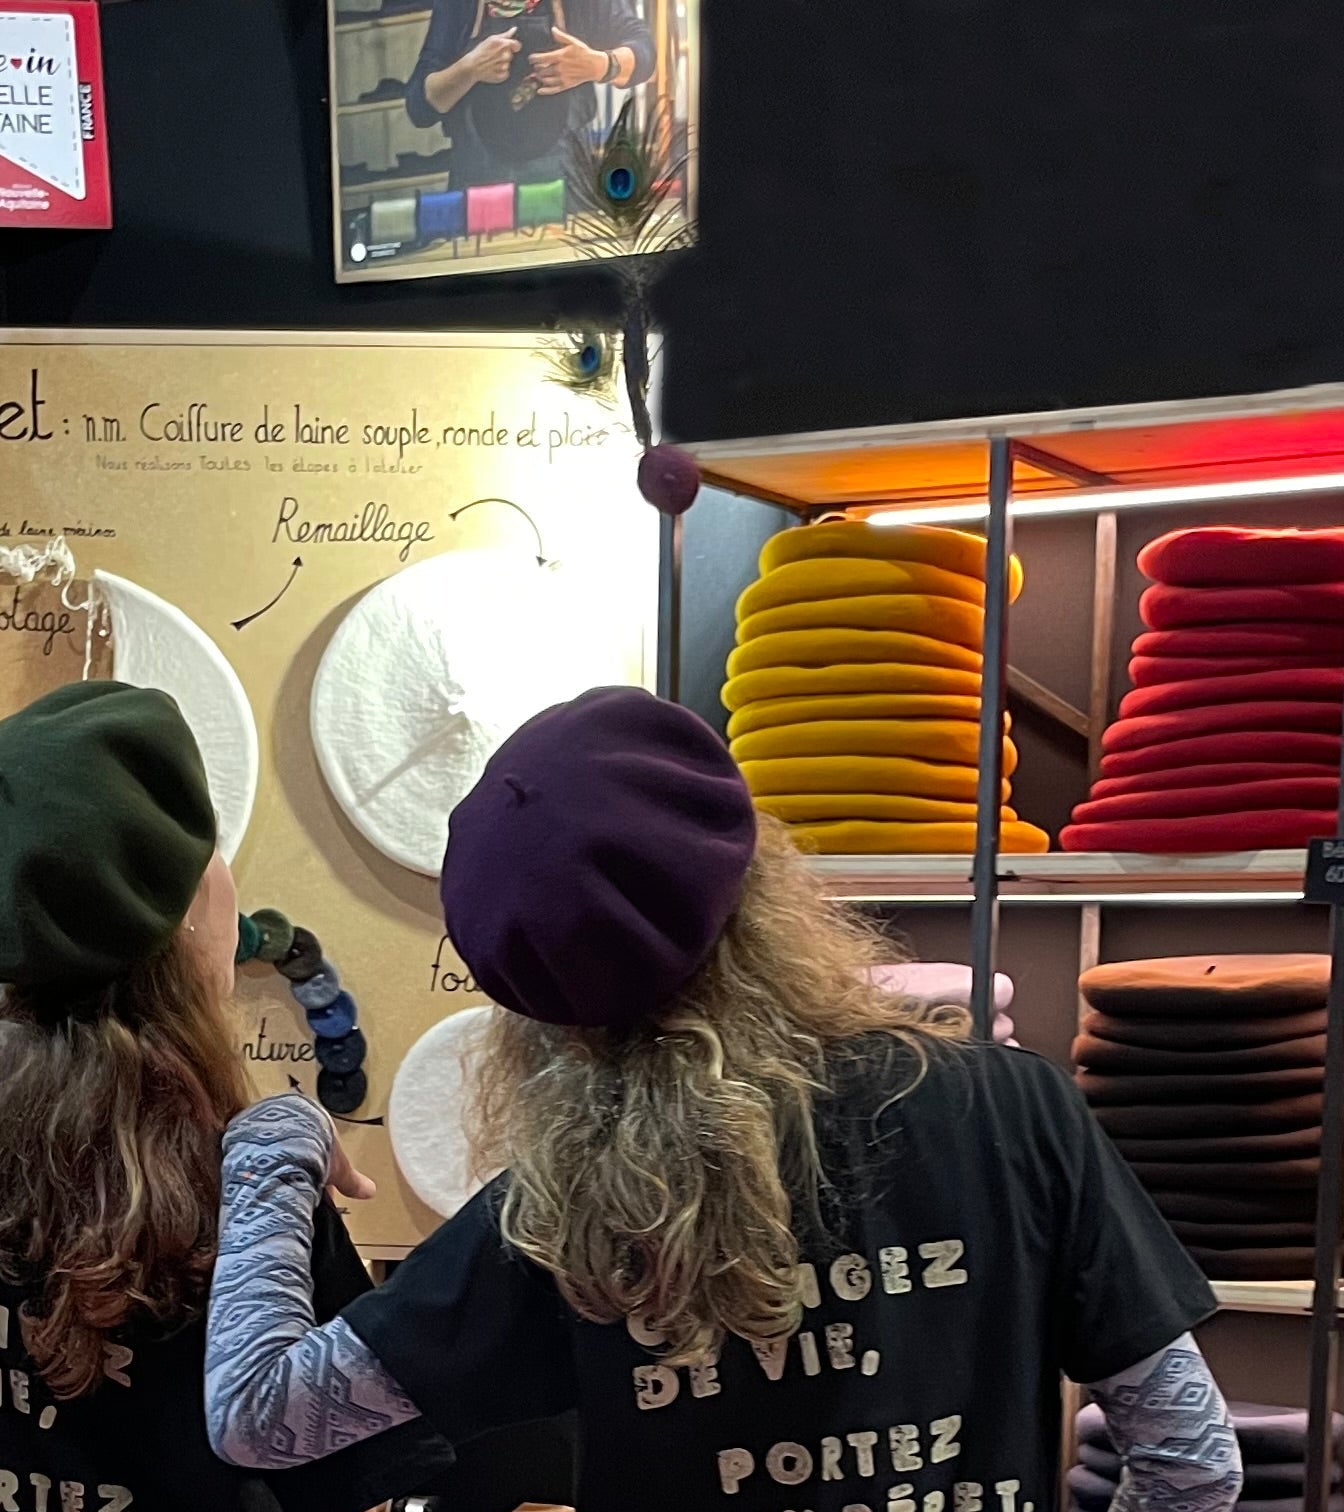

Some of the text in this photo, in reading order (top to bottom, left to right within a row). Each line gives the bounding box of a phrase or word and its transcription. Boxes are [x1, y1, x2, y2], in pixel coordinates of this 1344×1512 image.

[25, 47, 61, 75] in
[140, 402, 244, 443] Coiffure
[254, 404, 285, 443] de
[293, 404, 351, 444] laine
[442, 411, 509, 447] ronde
[516, 411, 541, 447] et
[271, 496, 436, 563] Remaillage
[632, 1359, 722, 1411] DE
[717, 1414, 963, 1495] PORTEZ
